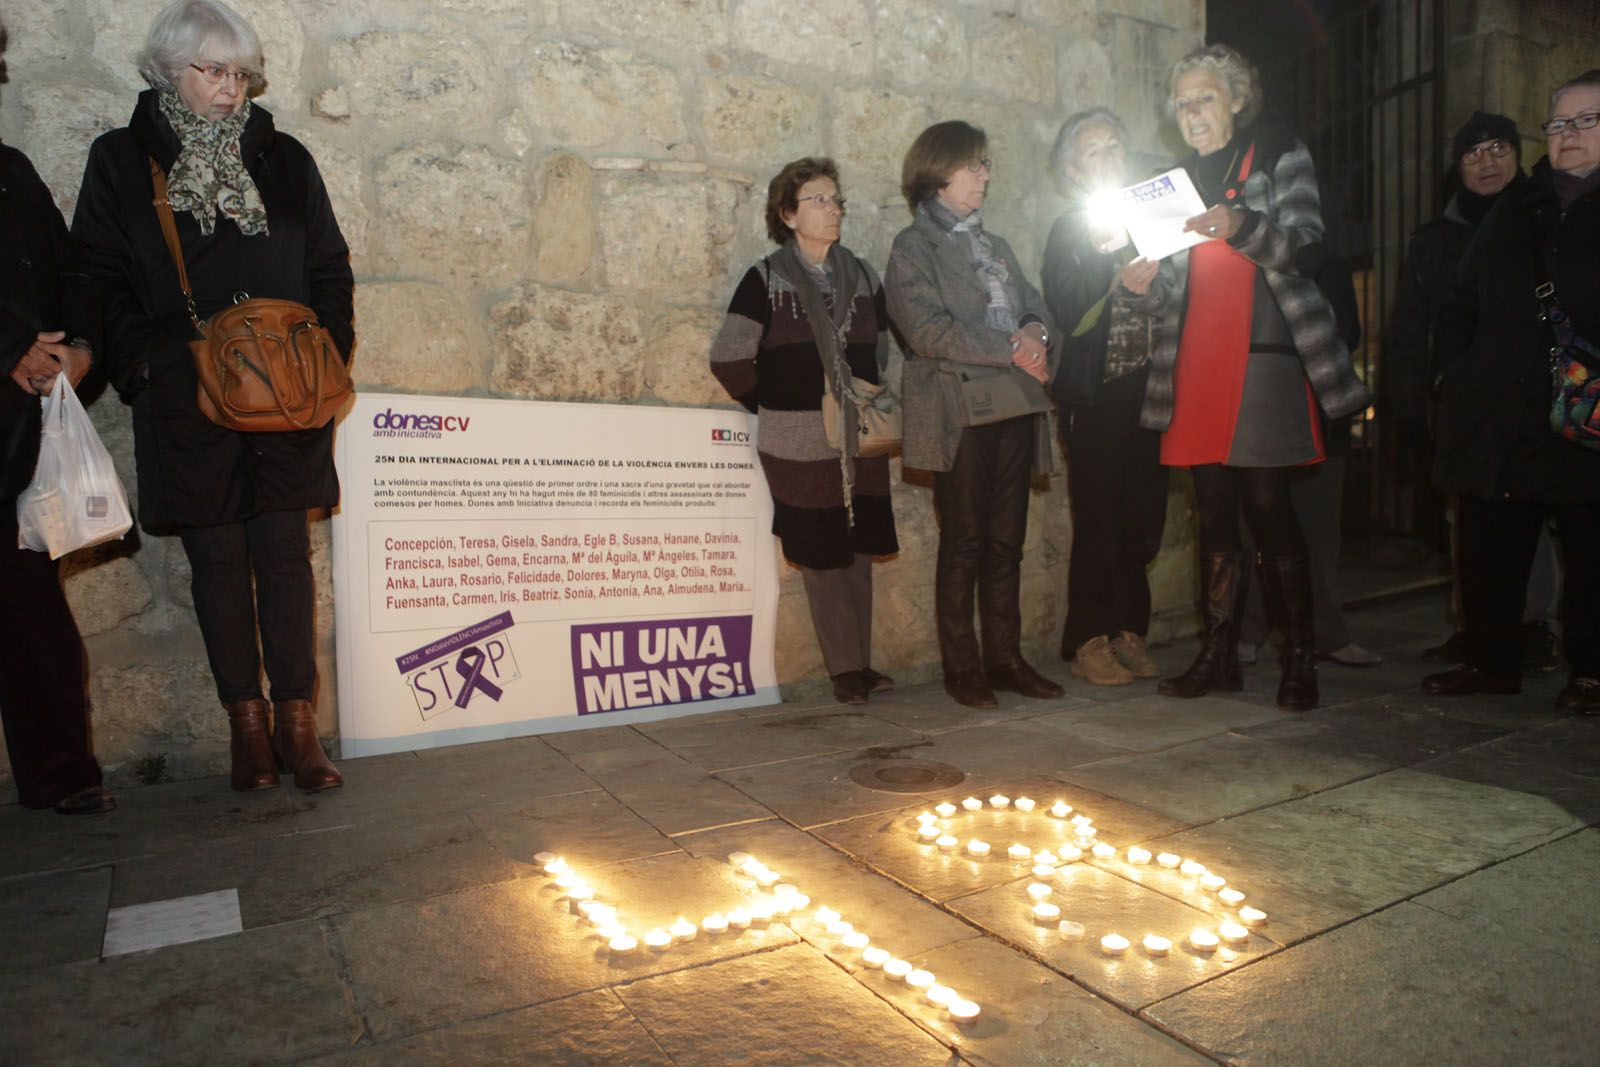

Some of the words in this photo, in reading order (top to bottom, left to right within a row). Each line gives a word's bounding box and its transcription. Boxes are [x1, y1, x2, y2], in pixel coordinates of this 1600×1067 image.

[733, 431, 750, 442] ICV
[374, 455, 395, 464] 25N
[398, 456, 416, 464] DIA
[419, 456, 499, 466] INTERNACIONAL
[502, 458, 520, 466] PER
[532, 458, 596, 467] L'ELIMINACIÓ
[612, 460, 624, 468] LA
[626, 459, 672, 468] VIOLÈNCIA
[674, 461, 708, 469] ENVERS
[710, 462, 726, 470] LES
[728, 462, 754, 470] DONES
[374, 478, 386, 486] La
[430, 479, 470, 487] masclista
[536, 480, 546, 488] de
[548, 480, 574, 489] primer
[576, 480, 598, 488] ordre
[666, 482, 696, 490] gravetat
[712, 482, 722, 490] cal
[724, 482, 751, 490] abordar
[374, 489, 394, 497] amb
[460, 489, 490, 499] Aquest
[492, 491, 508, 499] any
[532, 490, 556, 500] hagut
[576, 490, 586, 498] de
[588, 490, 598, 498] 80
[600, 490, 642, 498] feminicidis
[648, 491, 668, 499] altres
[670, 491, 713, 499] assassinats
[714, 491, 723, 499] de
[418, 501, 432, 510] per
[468, 500, 494, 508] Dones
[496, 500, 514, 508] amb
[516, 500, 554, 508] Iniciativa
[555, 500, 592, 508] denuncia
[598, 500, 628, 508] recorda
[630, 500, 641, 508] els
[642, 500, 684, 508] feminicidis
[385, 536, 456, 552] Concepción,
[460, 536, 499, 550] Teresa,
[502, 534, 538, 549] Gisela,
[541, 534, 580, 548] Sandra,
[584, 533, 606, 549] Egle
[609, 534, 620, 547] B,
[622, 532, 661, 547] Susana,
[664, 532, 702, 546] Hanane,
[704, 532, 741, 546] Davinia,
[385, 556, 444, 571] Francisca,
[448, 555, 484, 569] Isabel,
[486, 553, 520, 568] Gema,
[522, 552, 569, 567] Encarna,
[588, 551, 603, 564] del
[702, 548, 738, 562] Tamara,
[386, 576, 419, 590] Anka,
[422, 575, 457, 590] Laura,
[460, 573, 504, 588] Rosario,
[508, 570, 564, 586] Felicidade,
[567, 568, 609, 583] Dolores,
[612, 568, 650, 583] Maryna,
[654, 566, 679, 581] Olga,
[681, 566, 708, 580] Otilia,
[710, 564, 736, 578] Rosa,
[386, 595, 449, 610] Fuensanta,
[452, 592, 497, 607] Carmen,
[500, 590, 519, 604] Iris,
[522, 588, 561, 602] Beatriz,
[564, 586, 596, 601] Sonia,
[599, 584, 640, 599] Antonia,
[644, 584, 665, 598] Ana,
[668, 582, 717, 596] Almudena,
[580, 630, 624, 669] NI
[638, 624, 726, 664] UNA
[583, 661, 746, 713] MENYS!
